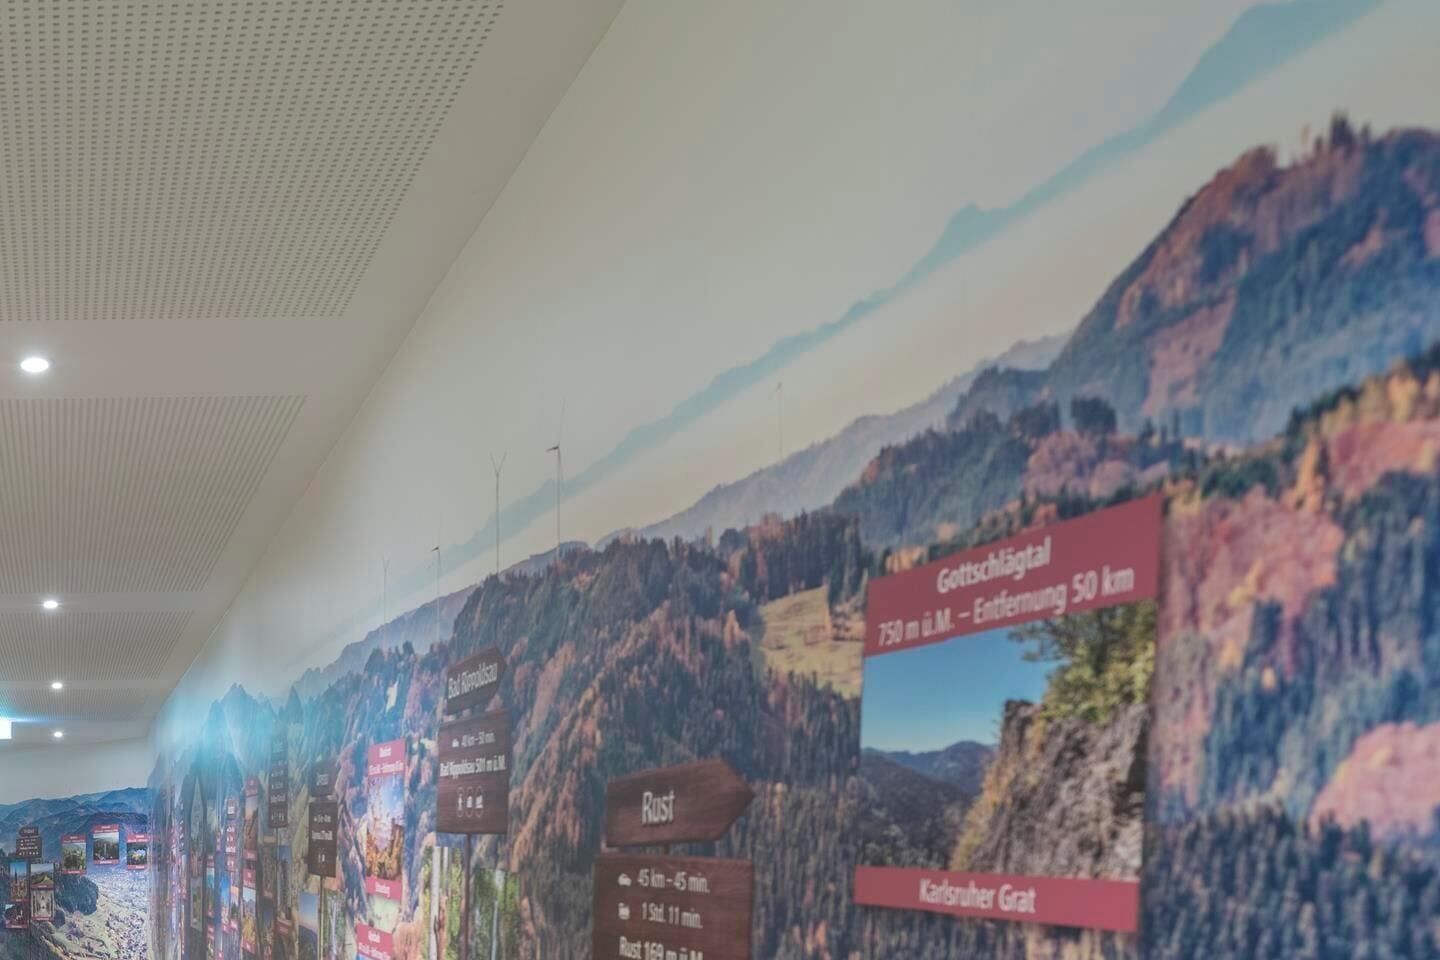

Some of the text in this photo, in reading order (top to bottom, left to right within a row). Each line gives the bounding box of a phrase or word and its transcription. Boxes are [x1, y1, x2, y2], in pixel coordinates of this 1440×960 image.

[936, 536, 1052, 595] Gottschlägtal
[878, 621, 904, 647] 750
[905, 620, 920, 643] m
[922, 608, 956, 637] ü.M.
[973, 583, 1067, 625] Entfernung
[1071, 570, 1099, 604] 50
[1100, 565, 1136, 597] km
[447, 673, 460, 699] Bad
[641, 789, 675, 824] Rust
[637, 868, 649, 887] 45
[650, 869, 665, 889] km
[673, 871, 687, 891] 45
[688, 872, 710, 893] min.
[919, 878, 1037, 914] Karlsruher Grat
[641, 902, 703, 929] 1 Std. 11 min.
[619, 936, 642, 960] Rust
